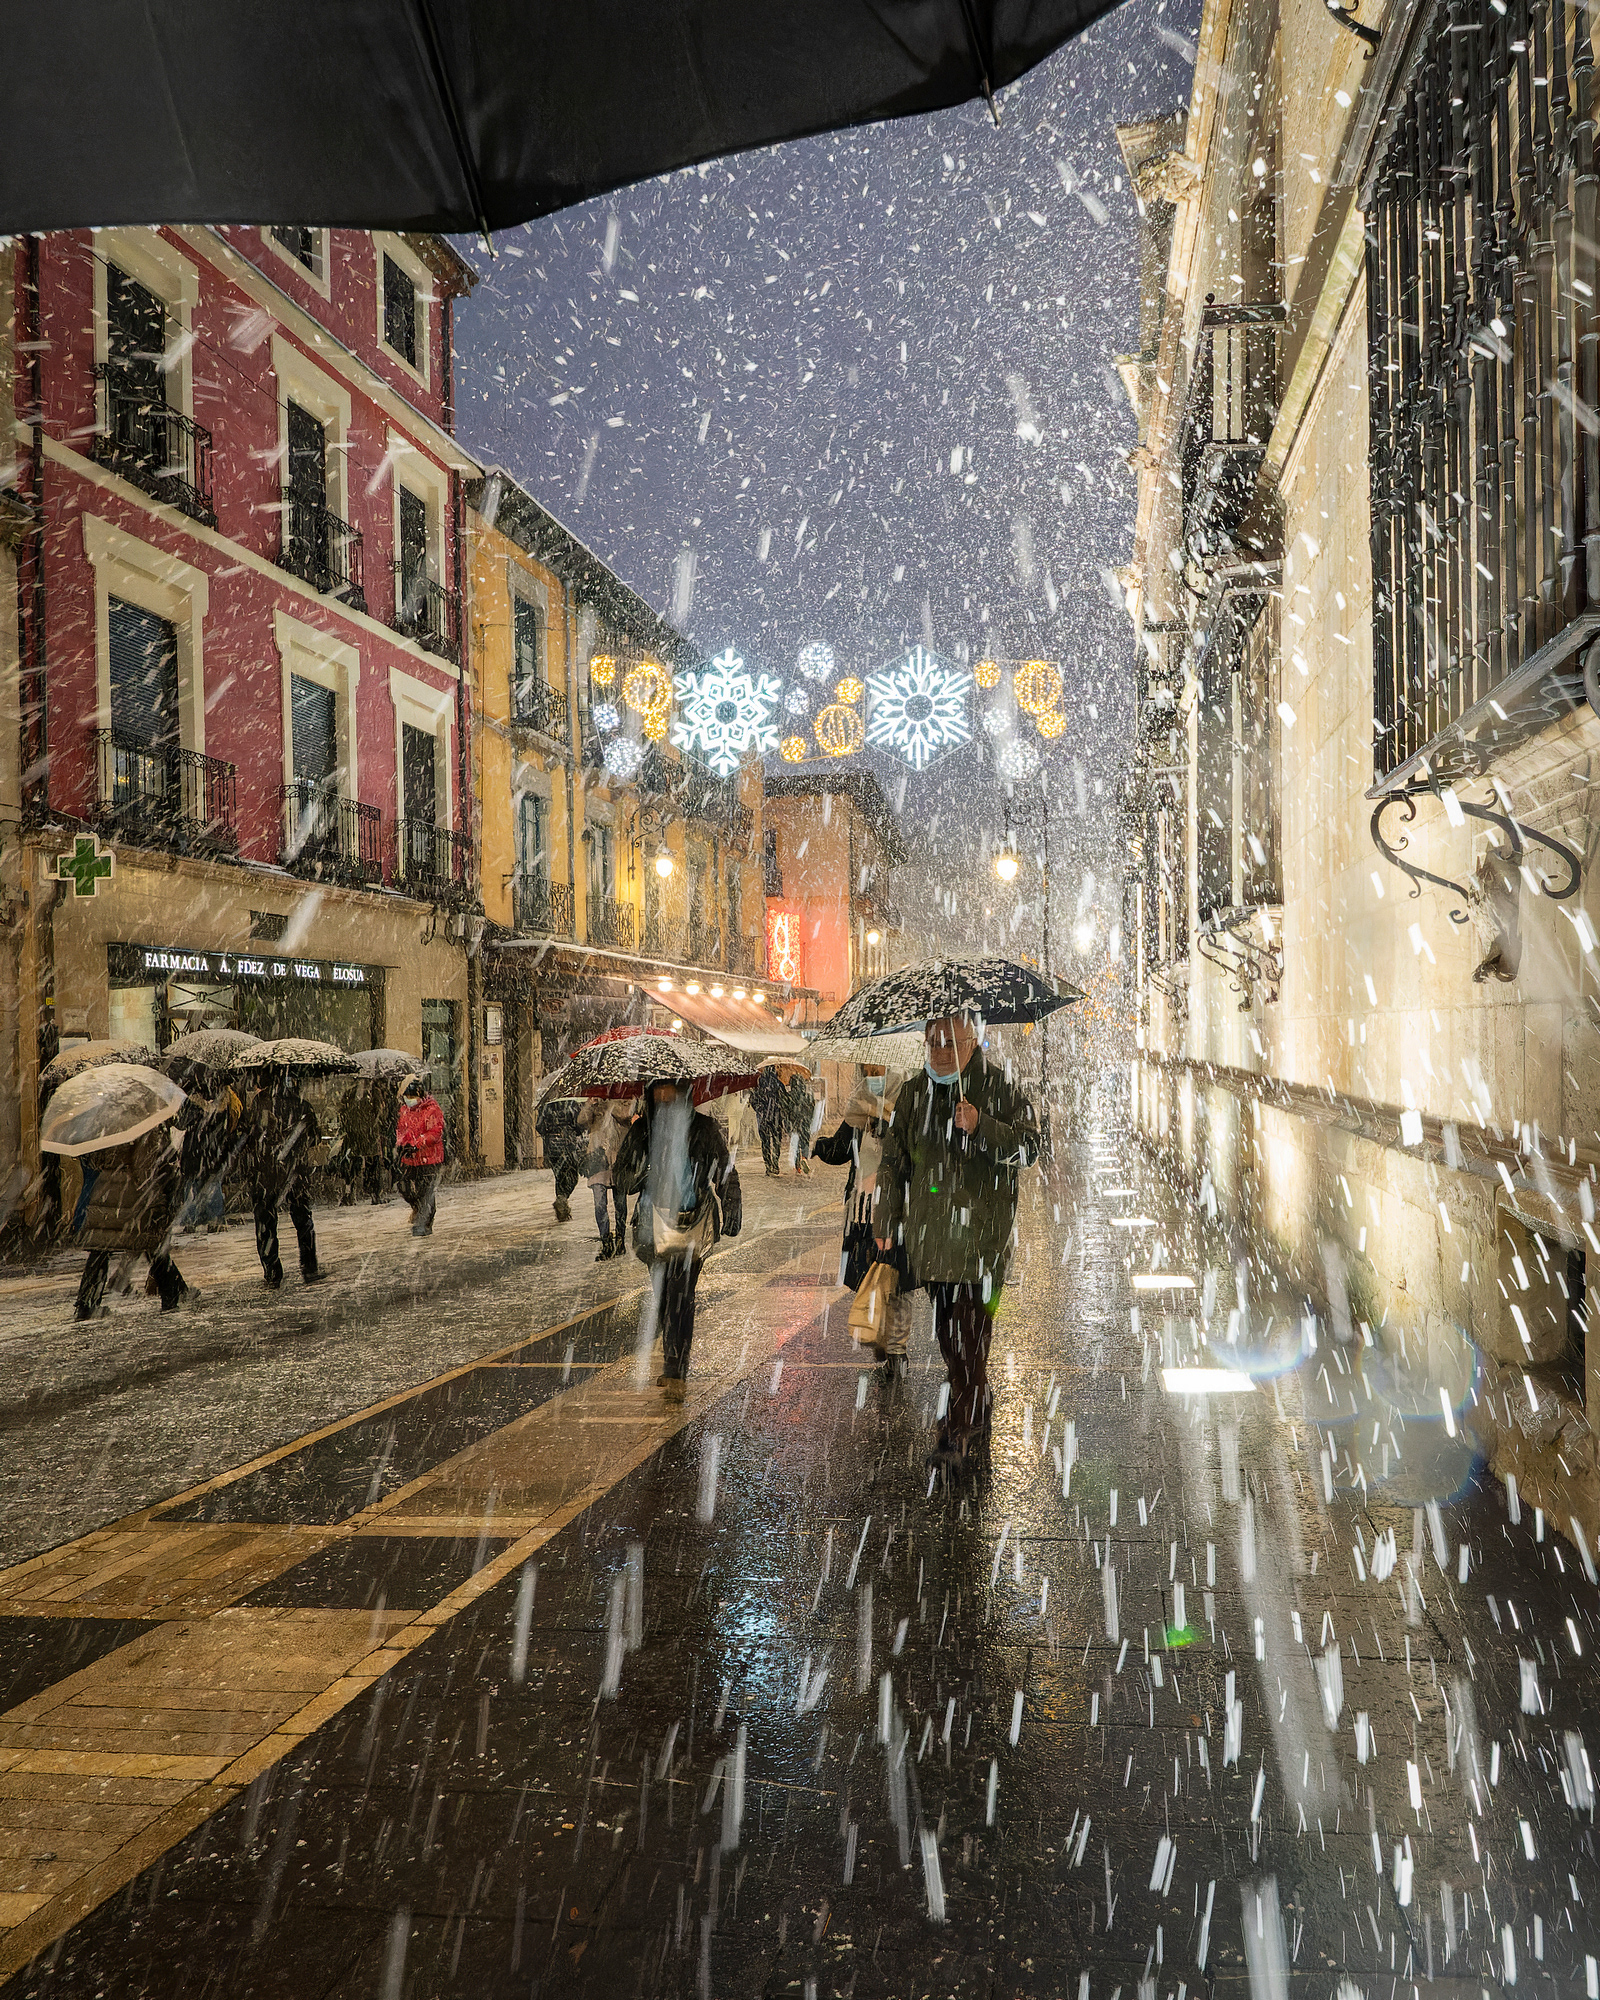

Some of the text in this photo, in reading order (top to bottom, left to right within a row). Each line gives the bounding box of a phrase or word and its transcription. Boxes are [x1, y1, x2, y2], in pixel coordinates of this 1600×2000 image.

[145, 953, 208, 971] FARMACIA
[237, 960, 264, 975] FDEZ
[273, 964, 286, 976] DE
[294, 965, 320, 978] VEGA
[333, 968, 364, 981] ELOSUA
